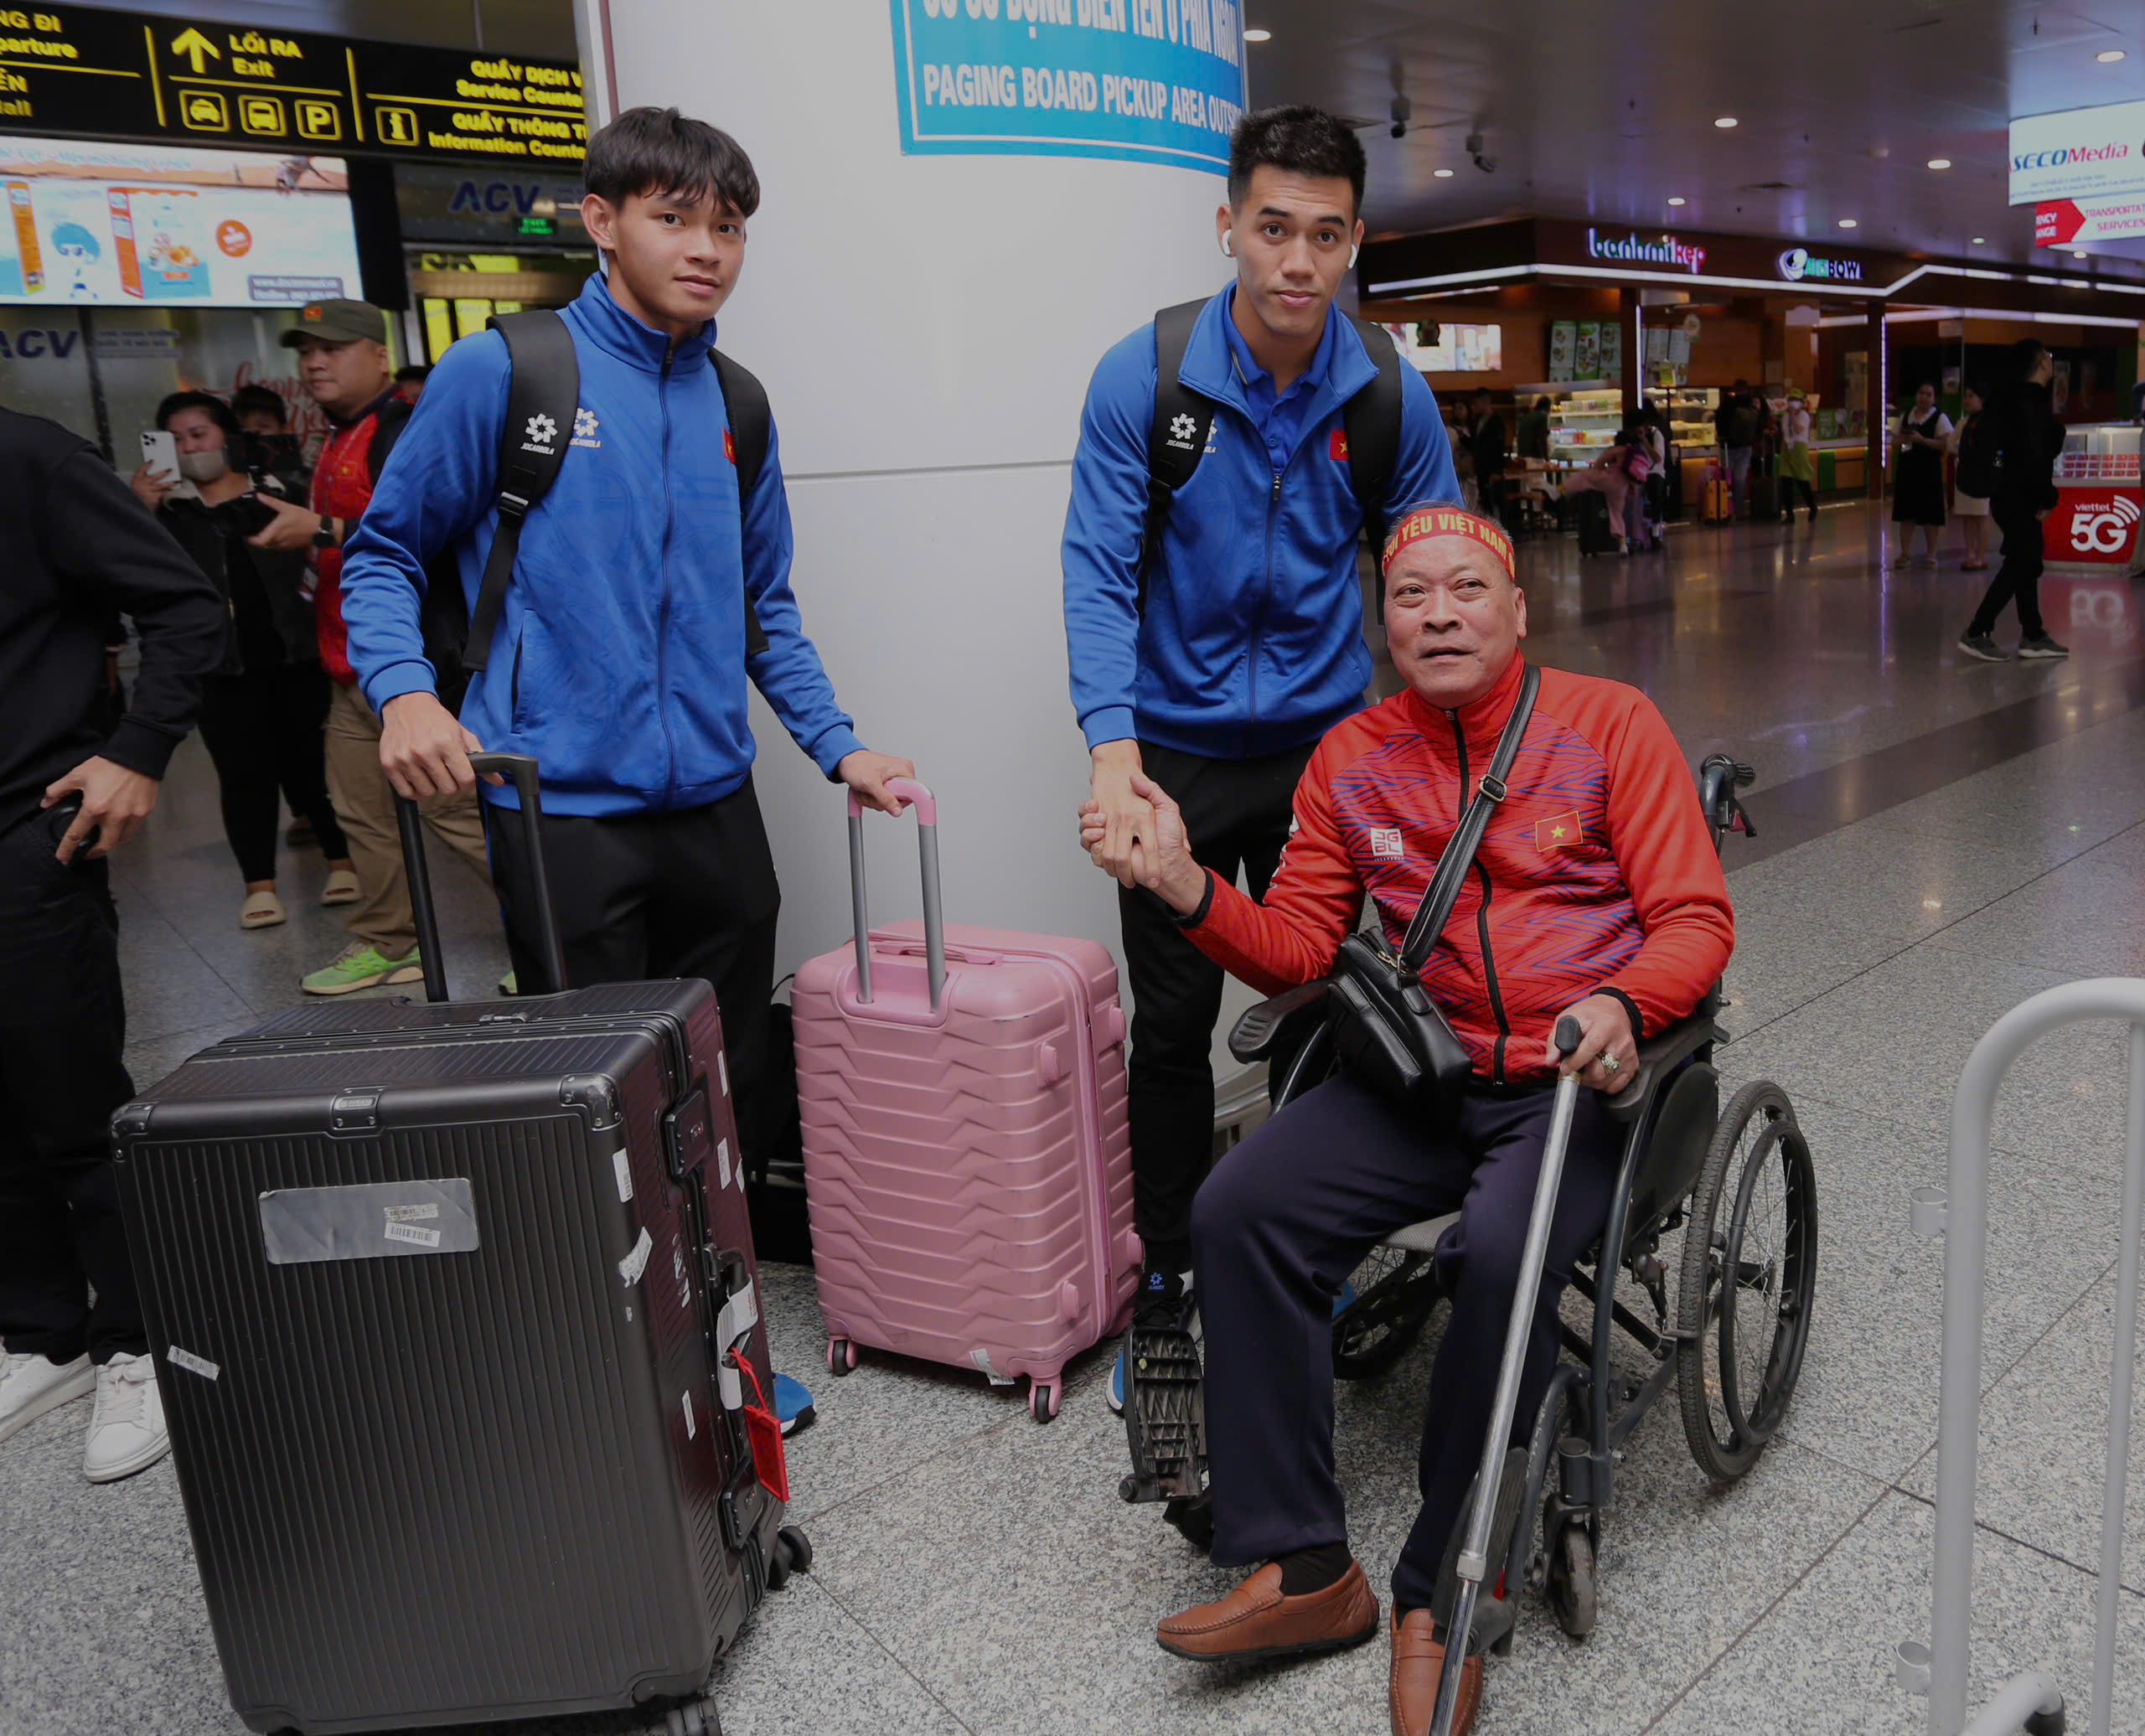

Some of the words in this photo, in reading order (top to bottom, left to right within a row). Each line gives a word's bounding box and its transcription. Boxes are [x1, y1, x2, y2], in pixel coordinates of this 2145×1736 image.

[270, 39, 303, 59] RA
[232, 56, 276, 79] Exit
[456, 79, 522, 102] Service
[923, 64, 1017, 107] PAGING
[1021, 67, 1097, 111] BOARD
[1102, 74, 1167, 120] PICKUP
[1171, 85, 1207, 129] AREA
[506, 116, 571, 139] THÔNG
[428, 131, 527, 155] Information
[451, 181, 540, 214] ACV
[2074, 503, 2111, 512] viettel
[1402, 515, 1433, 541] YÊU
[1437, 513, 1475, 535] VIỆT
[1479, 524, 1507, 561] NAM
[2070, 513, 2127, 554] 5G
